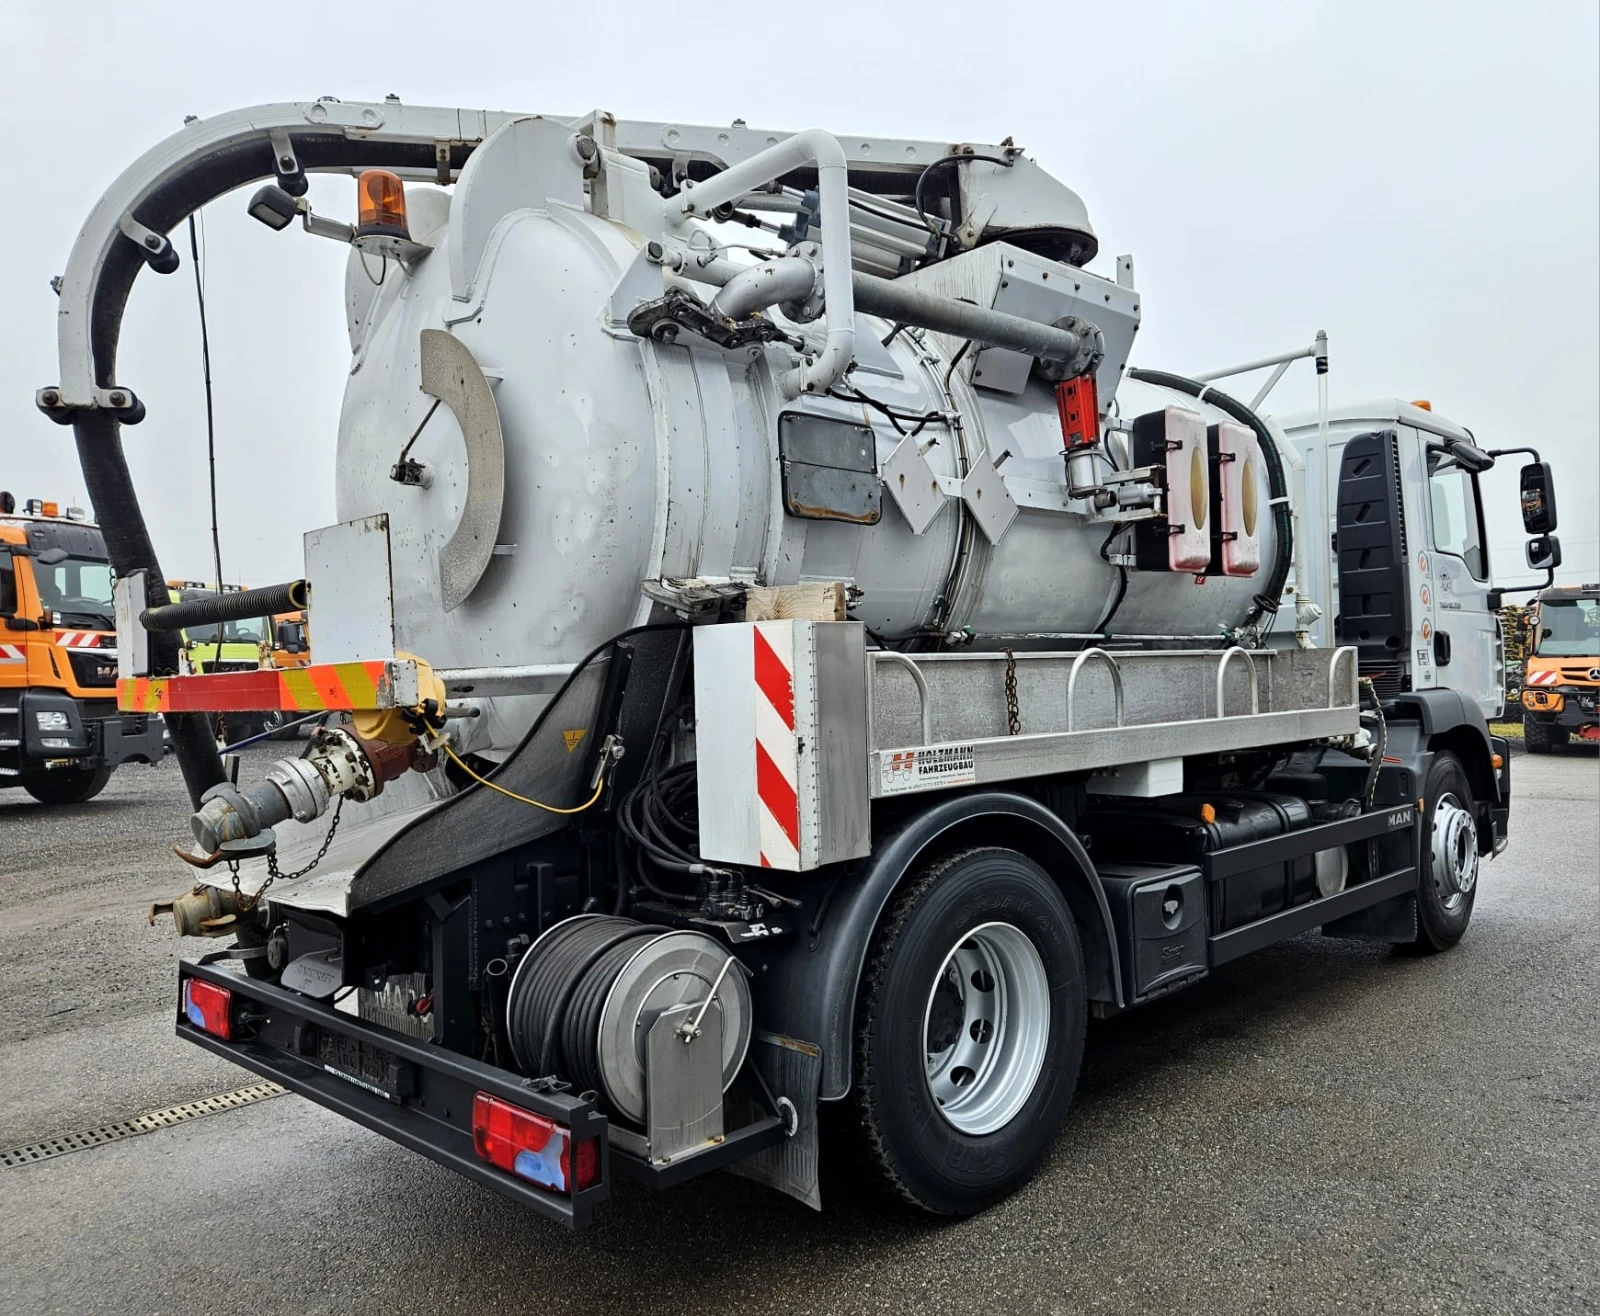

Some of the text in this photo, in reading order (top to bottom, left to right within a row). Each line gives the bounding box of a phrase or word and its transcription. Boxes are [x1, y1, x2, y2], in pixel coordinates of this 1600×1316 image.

[97, 666, 118, 678] MA
[918, 760, 974, 775] FAHRZEUGBAU
[1388, 810, 1411, 827] MAN
